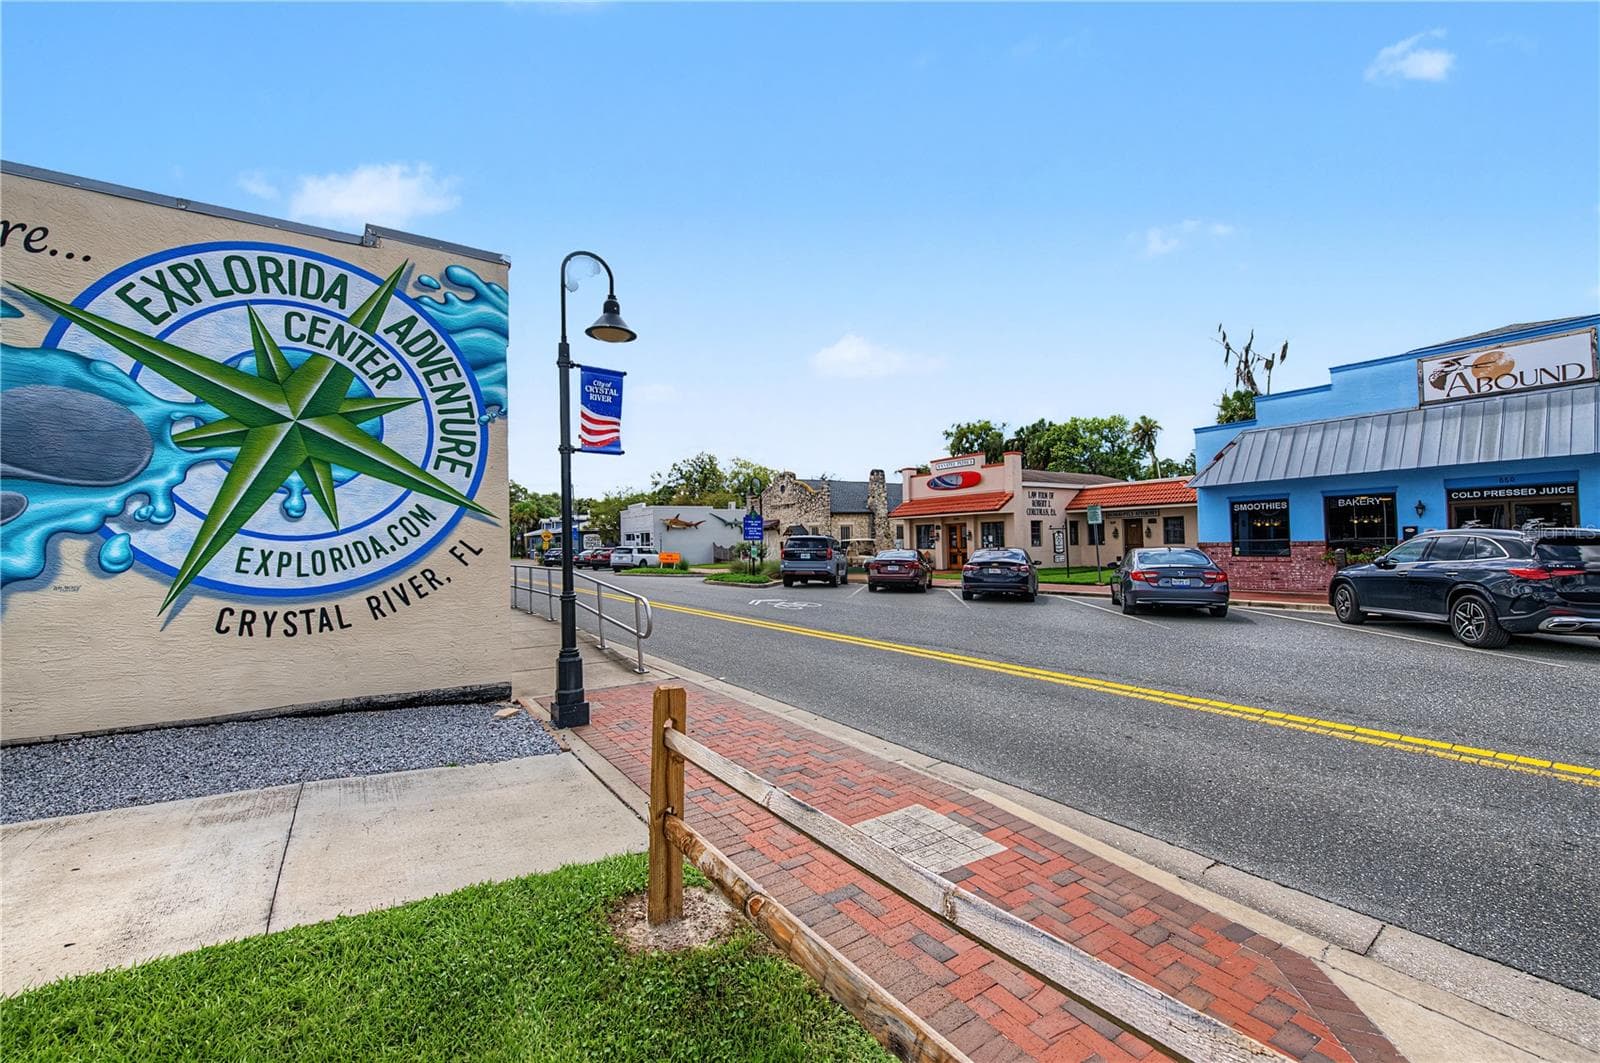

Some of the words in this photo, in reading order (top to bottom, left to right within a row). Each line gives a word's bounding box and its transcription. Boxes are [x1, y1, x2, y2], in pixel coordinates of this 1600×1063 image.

[284, 310, 404, 390] CENTER
[115, 255, 349, 326] EXPLORIDA
[383, 314, 479, 480] ADVENTURE
[592, 379, 605, 388] City
[584, 385, 619, 397] CRYSTAL
[589, 393, 612, 403] RIVER
[1451, 490, 1481, 499] COLD
[1483, 487, 1537, 498] PRESSED
[1539, 486, 1575, 495] JUICE
[1233, 501, 1288, 511] SMOOTHIES
[1338, 497, 1382, 507] BAKERY
[234, 503, 438, 578] EXPLORIDA.COM
[214, 604, 353, 638] CRYSTAL
[366, 567, 452, 620] RIVER,
[448, 539, 484, 567] FL
